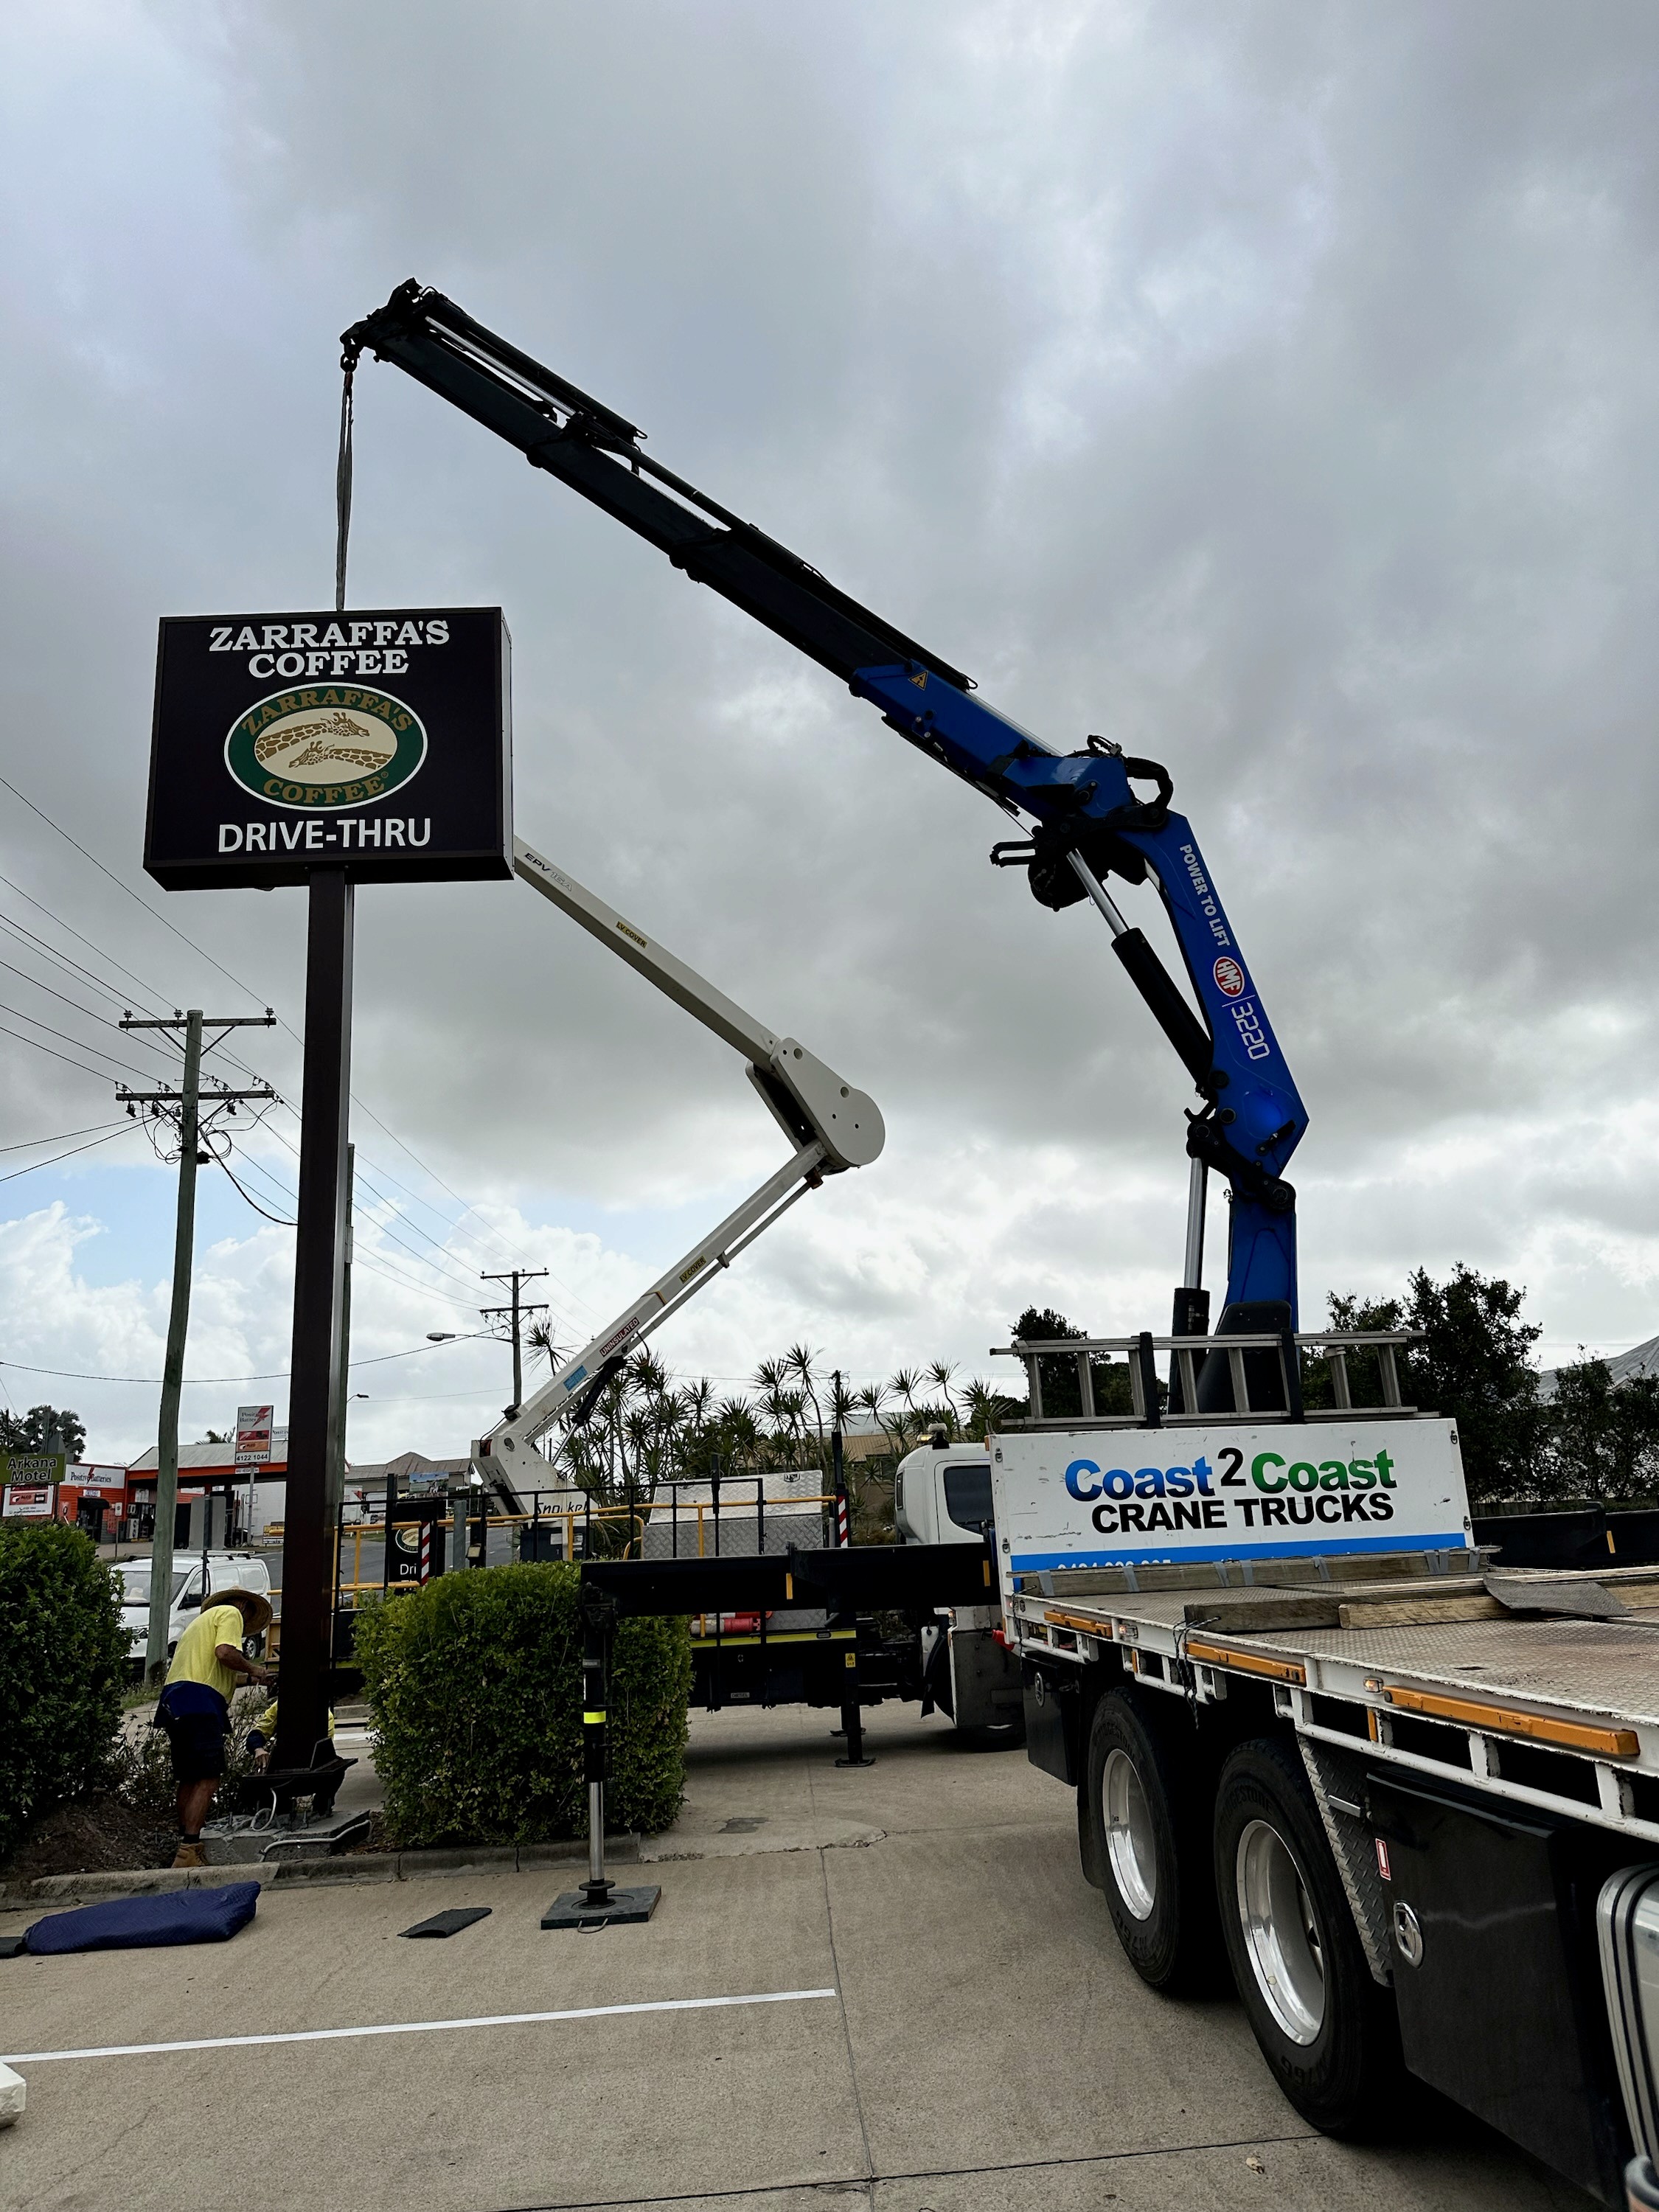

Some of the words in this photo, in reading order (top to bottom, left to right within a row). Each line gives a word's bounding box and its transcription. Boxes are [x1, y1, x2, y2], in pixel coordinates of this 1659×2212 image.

[209, 620, 450, 652] ZARRAFFA'S
[248, 650, 409, 678] COFFEE
[241, 689, 413, 736] ZARRAFFA'S
[263, 774, 385, 804] COFFEE
[218, 818, 431, 852] DRIVE-THRU
[525, 852, 552, 872] EPV
[550, 872, 572, 891] 16A
[1180, 844, 1207, 895] POWER
[1200, 895, 1217, 917] TO
[616, 922, 625, 931] LV
[625, 929, 646, 947] COVER
[1208, 918, 1231, 947] LIFT
[1217, 960, 1242, 992] HMF
[1231, 1001, 1270, 1060] 3220
[679, 1273, 688, 1283] LV
[687, 1257, 706, 1276] COVER
[601, 1318, 639, 1356] UNINSULATED
[7, 1456, 57, 1470] Arkana
[11, 1468, 52, 1483] Motel
[1065, 1455, 1215, 1502] Coast
[1217, 1447, 1247, 1486] 2
[1251, 1449, 1397, 1494] Coast
[538, 1500, 588, 1514] Snokel
[1091, 1499, 1228, 1533] CRANE
[1234, 1492, 1394, 1527] TRUCKS
[400, 1563, 417, 1575] Dri
